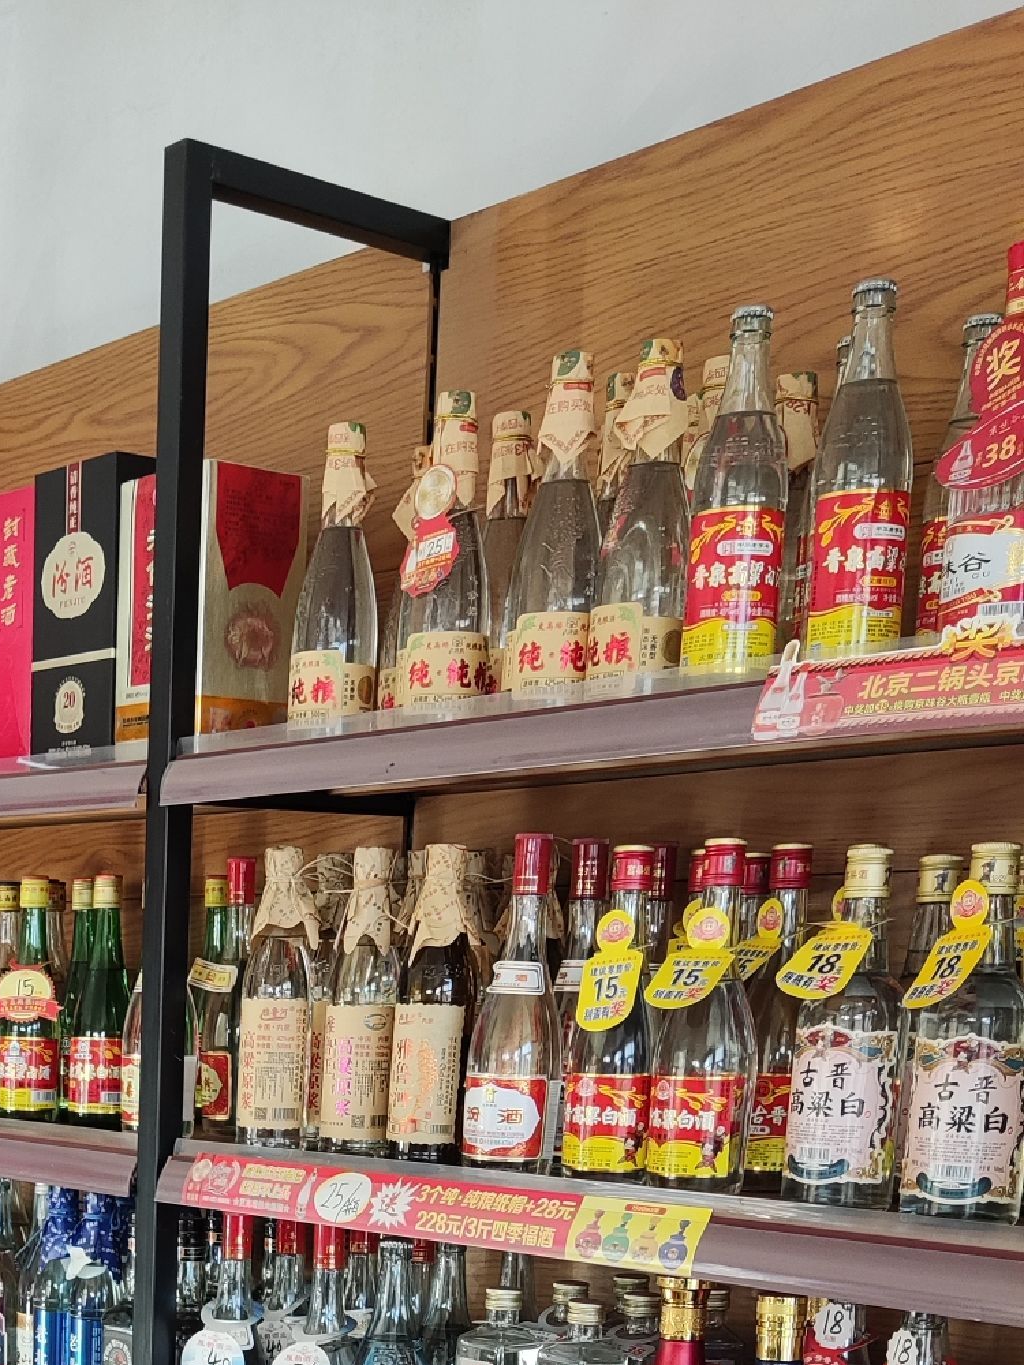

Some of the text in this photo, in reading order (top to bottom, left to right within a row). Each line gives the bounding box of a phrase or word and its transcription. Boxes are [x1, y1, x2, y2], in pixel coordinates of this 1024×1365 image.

[987, 339, 1021, 391] 奖
[982, 433, 1018, 469] 38
[51, 555, 94, 599] 汾酒
[62, 691, 76, 708] 20
[933, 1073, 998, 1105] 古晋
[918, 1103, 1009, 1135] 高粱白
[414, 1210, 557, 1249] 228元/3斤四季福酒
[822, 1309, 845, 1336] 18
[892, 1335, 913, 1365] 18
